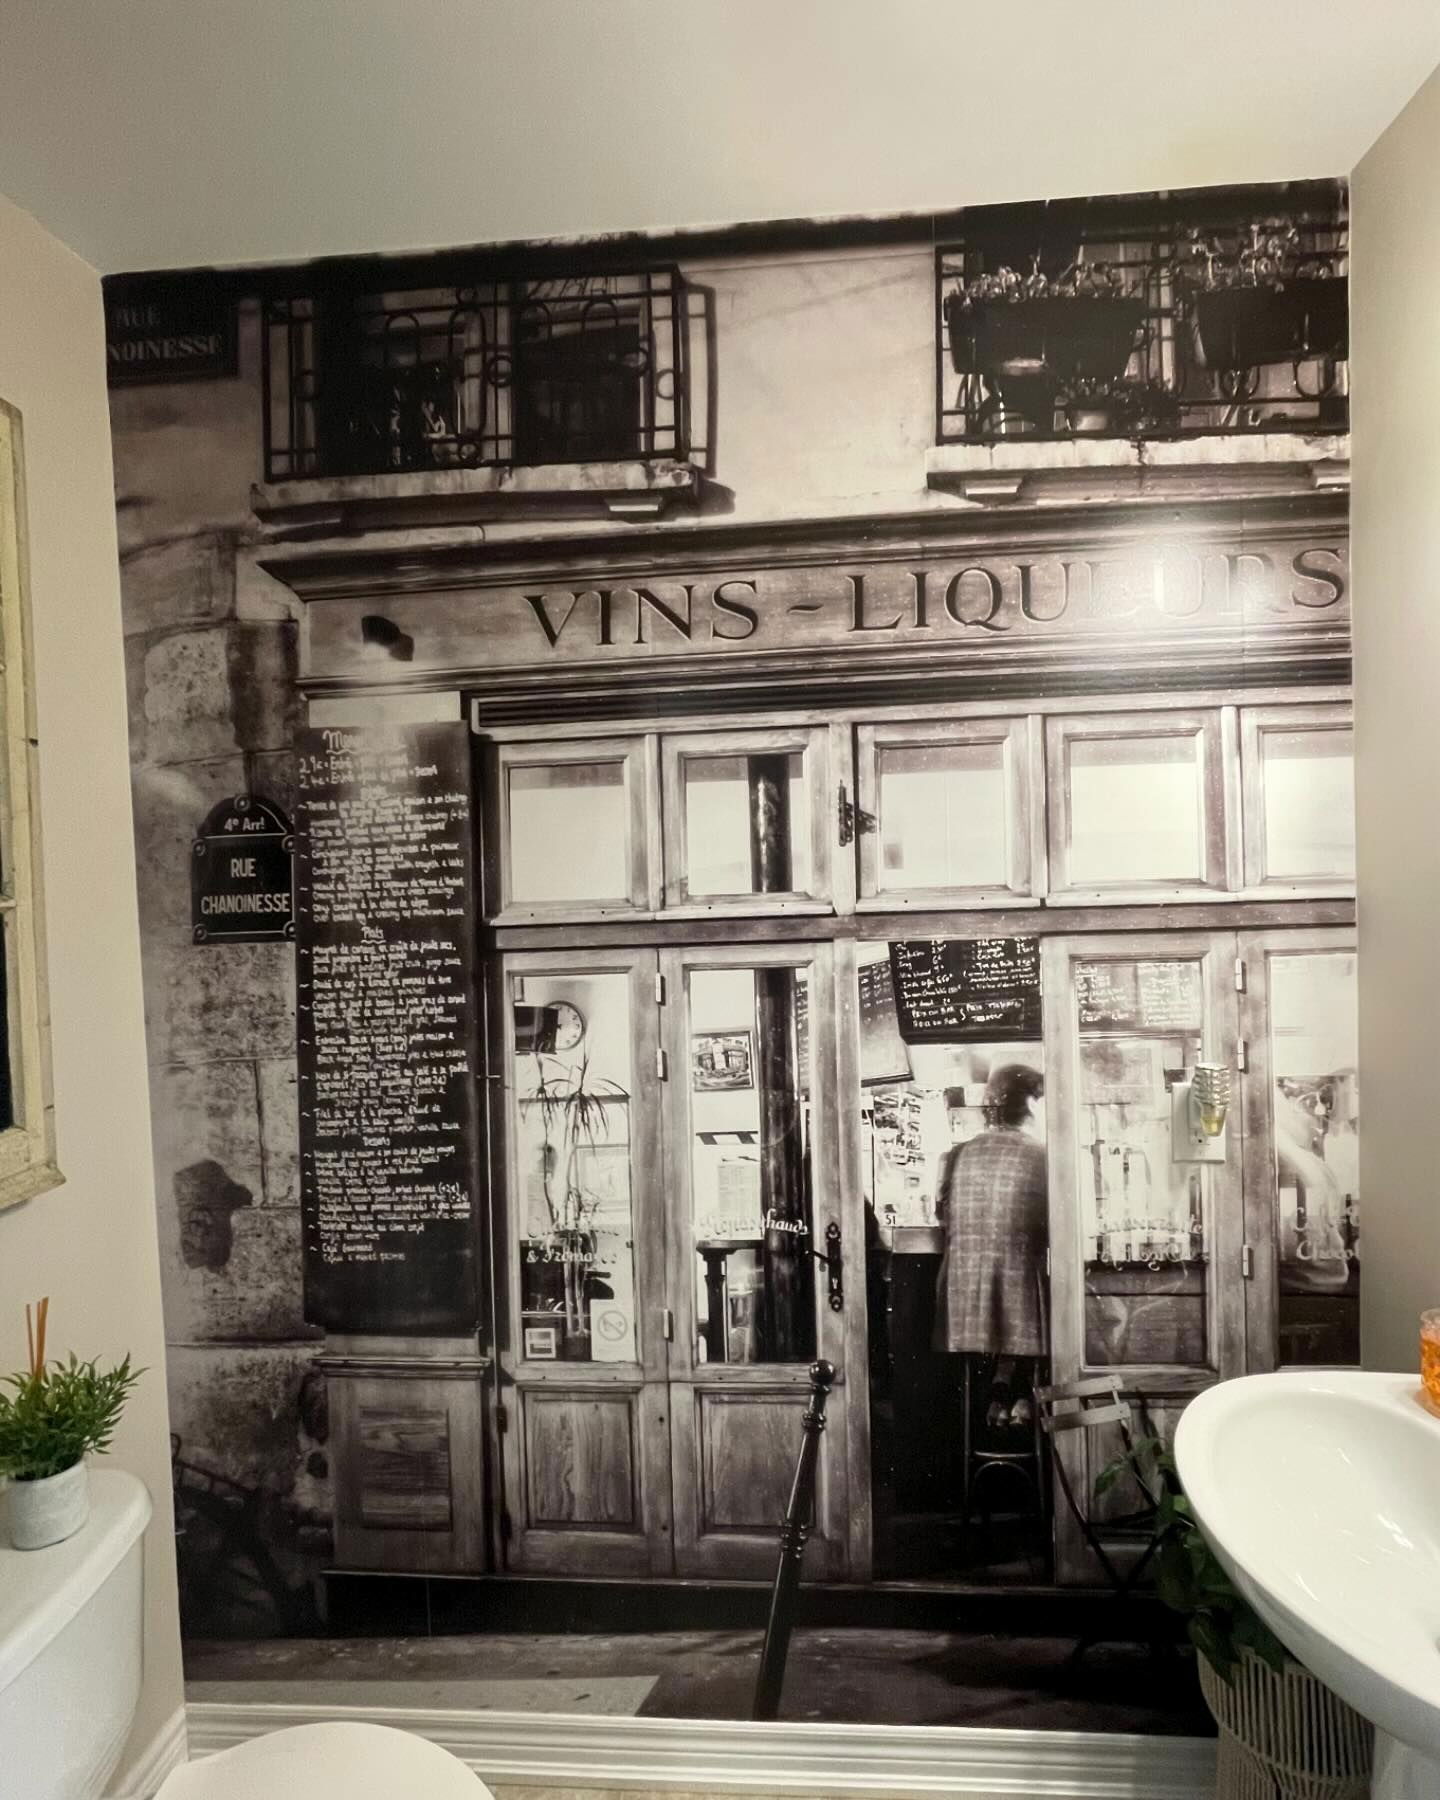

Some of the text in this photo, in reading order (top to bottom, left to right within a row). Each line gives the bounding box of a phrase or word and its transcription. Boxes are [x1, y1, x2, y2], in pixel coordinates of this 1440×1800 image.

[523, 580, 760, 649] VINS
[230, 857, 257, 878] RUE
[200, 893, 290, 914] CHANOINESSE
